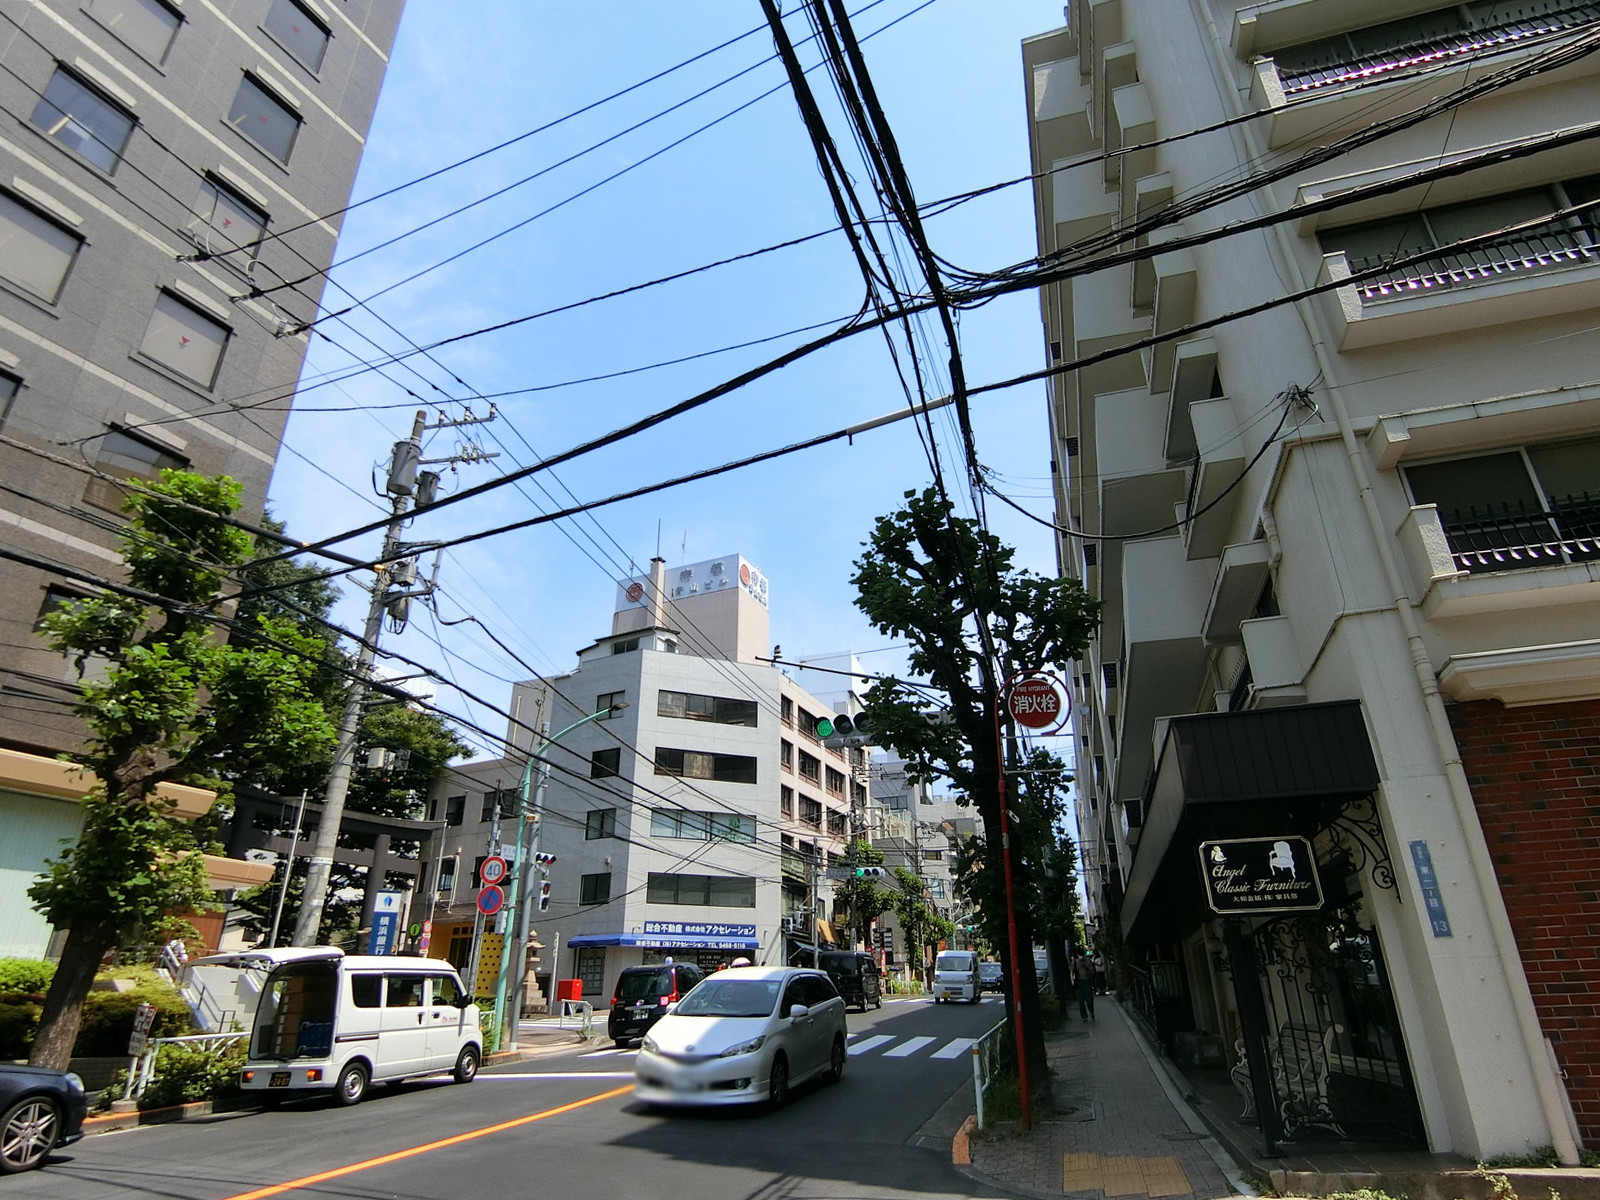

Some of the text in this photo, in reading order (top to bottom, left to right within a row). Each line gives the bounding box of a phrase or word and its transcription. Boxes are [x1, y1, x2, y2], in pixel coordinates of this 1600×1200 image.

[1013, 693, 1056, 713] 消火栓
[486, 864, 501, 876] 40
[1212, 864, 1247, 881] Angel
[1214, 879, 1311, 893] Classic Furniture
[646, 923, 682, 933] 総合不動産
[1433, 921, 1447, 932] 13
[375, 916, 390, 955] 横浜銀行
